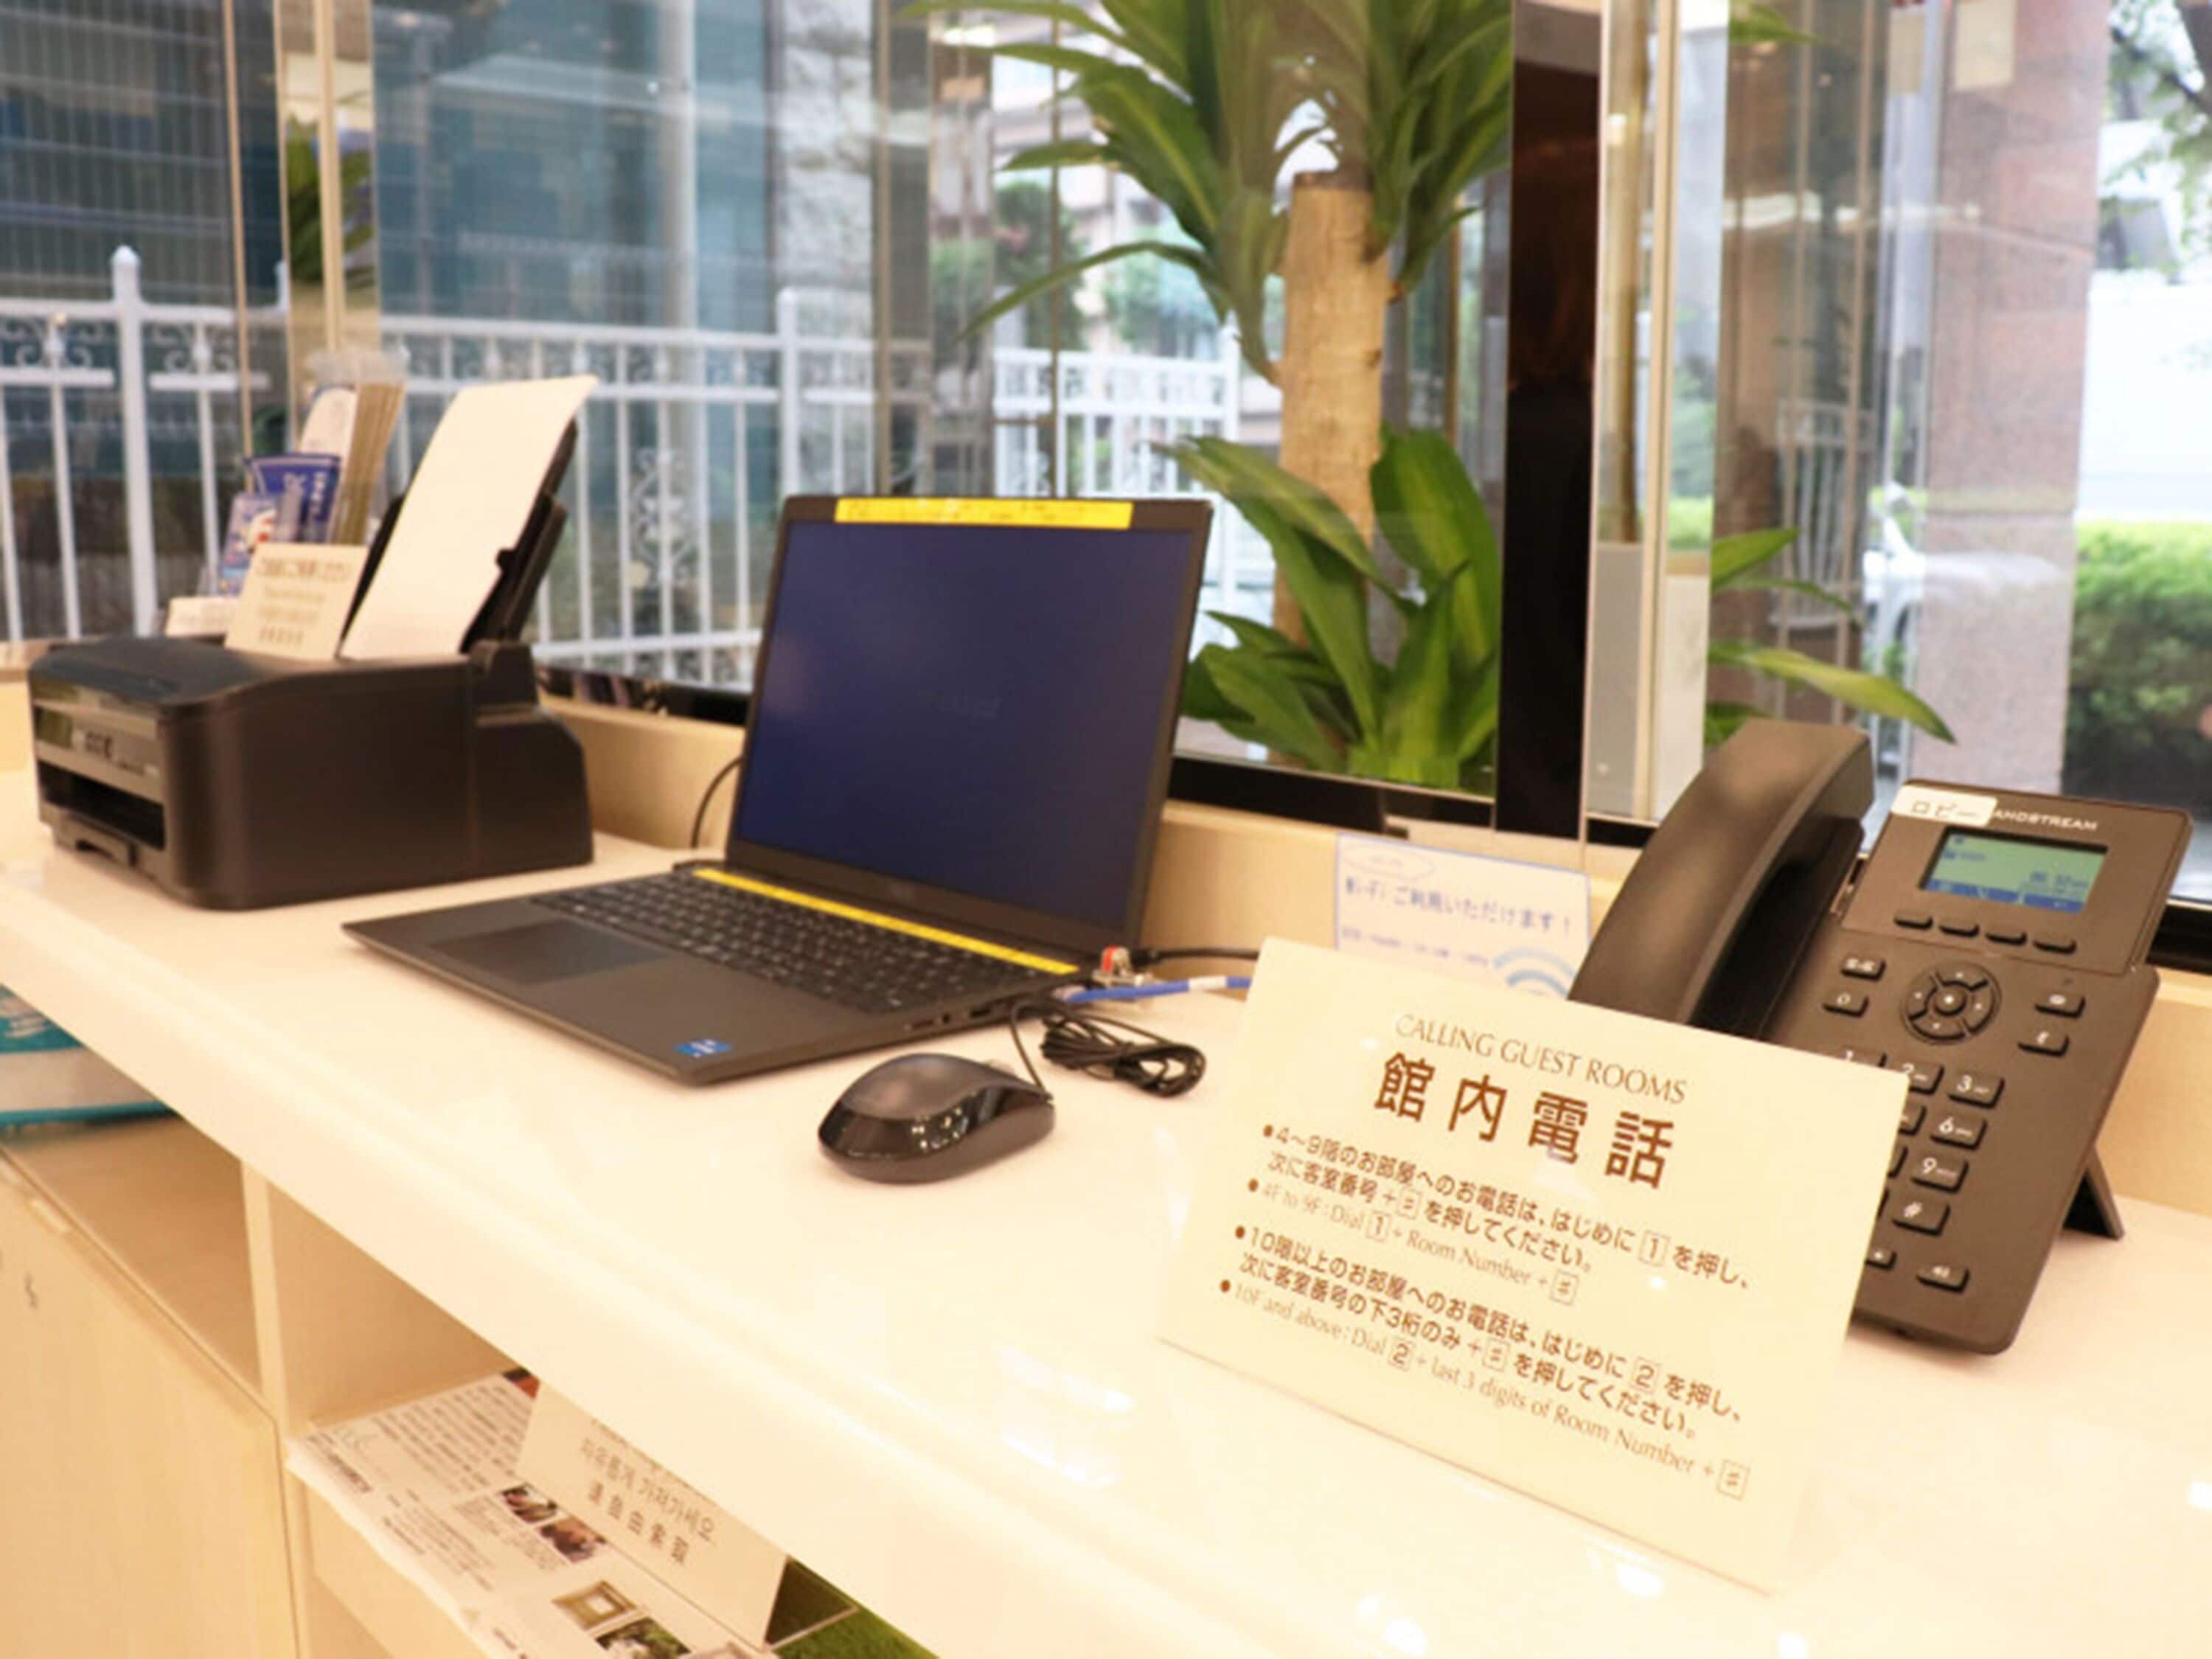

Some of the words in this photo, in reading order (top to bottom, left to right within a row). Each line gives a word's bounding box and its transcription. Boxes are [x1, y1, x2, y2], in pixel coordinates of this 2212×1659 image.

[1395, 1013, 1495, 1057] CALLING
[1500, 1034, 1582, 1078] GUEST
[1585, 1057, 1688, 1105] ROOMS
[1956, 1074, 1973, 1093] 3
[1372, 1051, 1675, 1189] 館内電話
[1938, 1116, 1955, 1134] 6
[1921, 1156, 1938, 1175] 9
[1330, 1205, 1363, 1230] Dial
[1407, 1229, 1456, 1260] Room
[1461, 1246, 1531, 1285] Number
[1263, 1299, 1295, 1320] and
[1352, 1329, 1387, 1357] Dial
[1431, 1356, 1461, 1386] last
[1463, 1371, 1475, 1390] 3
[1478, 1377, 1527, 1411] digits
[1530, 1394, 1550, 1419] of
[1553, 1405, 1610, 1444] Room
[1615, 1428, 1696, 1474] Number
